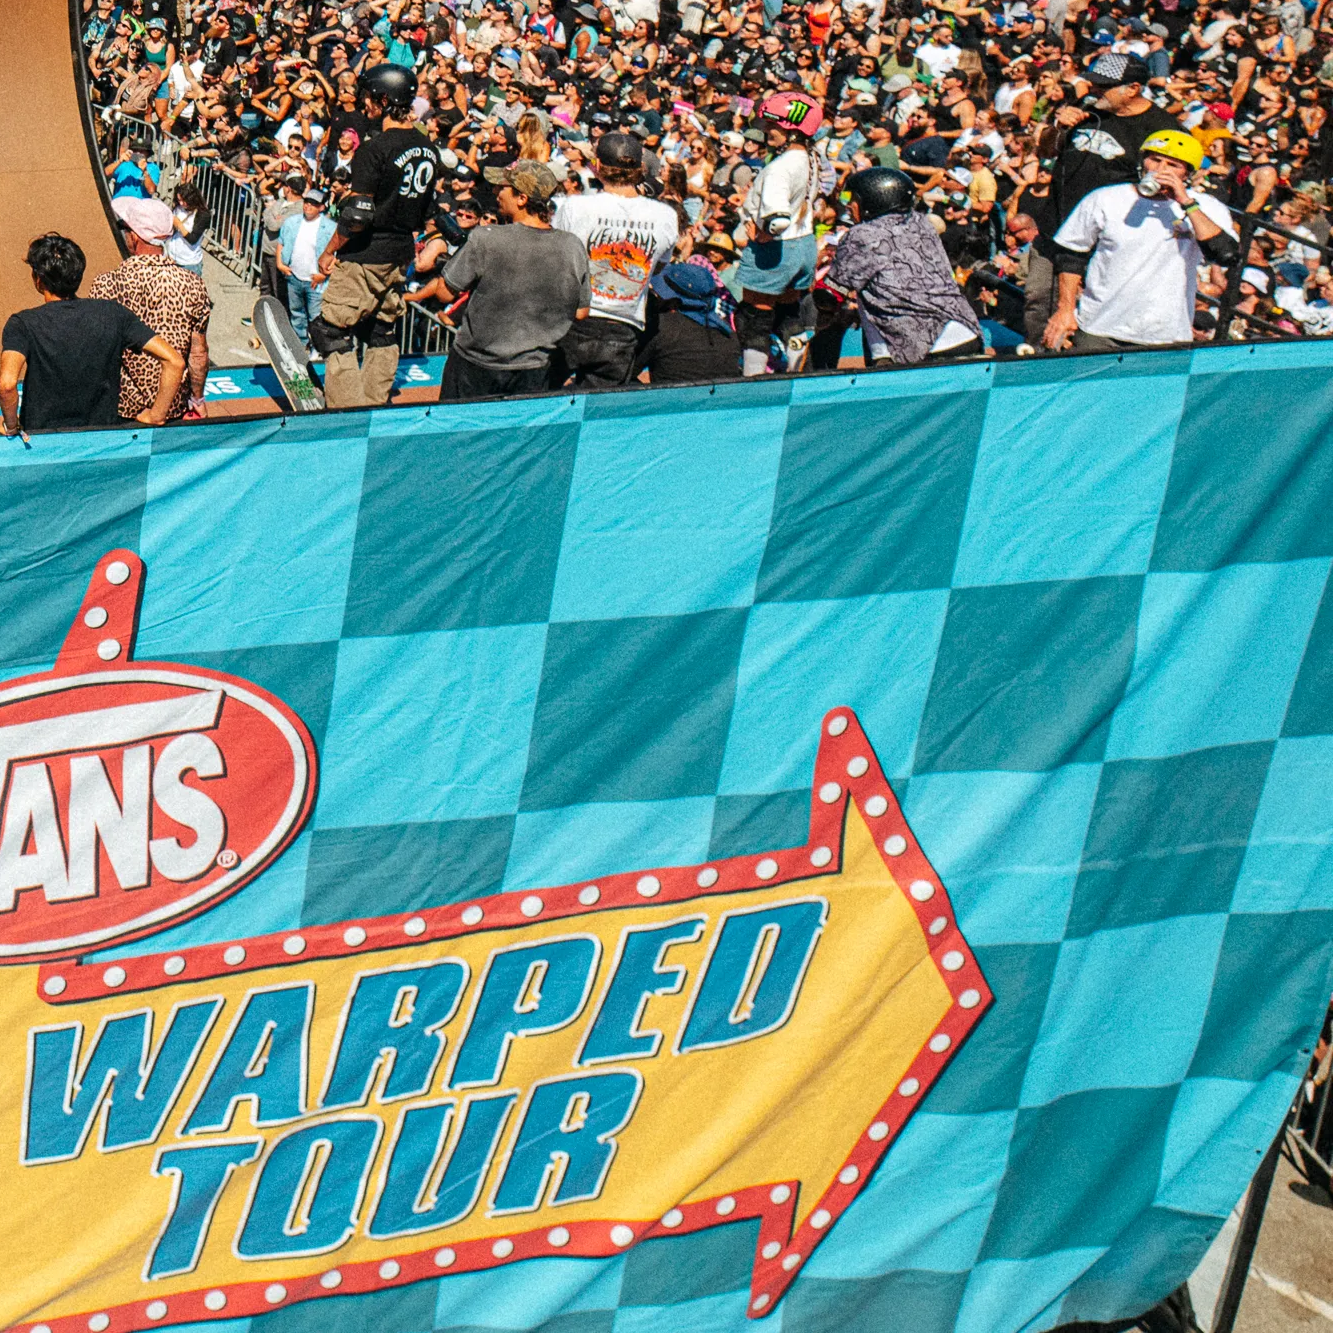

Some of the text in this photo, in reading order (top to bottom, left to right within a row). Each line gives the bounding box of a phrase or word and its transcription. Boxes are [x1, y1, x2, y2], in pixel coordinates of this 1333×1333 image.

[394, 147, 421, 168] WARPED
[399, 161, 433, 195] 30
[19, 896, 831, 1167] WARPED
[140, 1067, 644, 1282] TOUR
